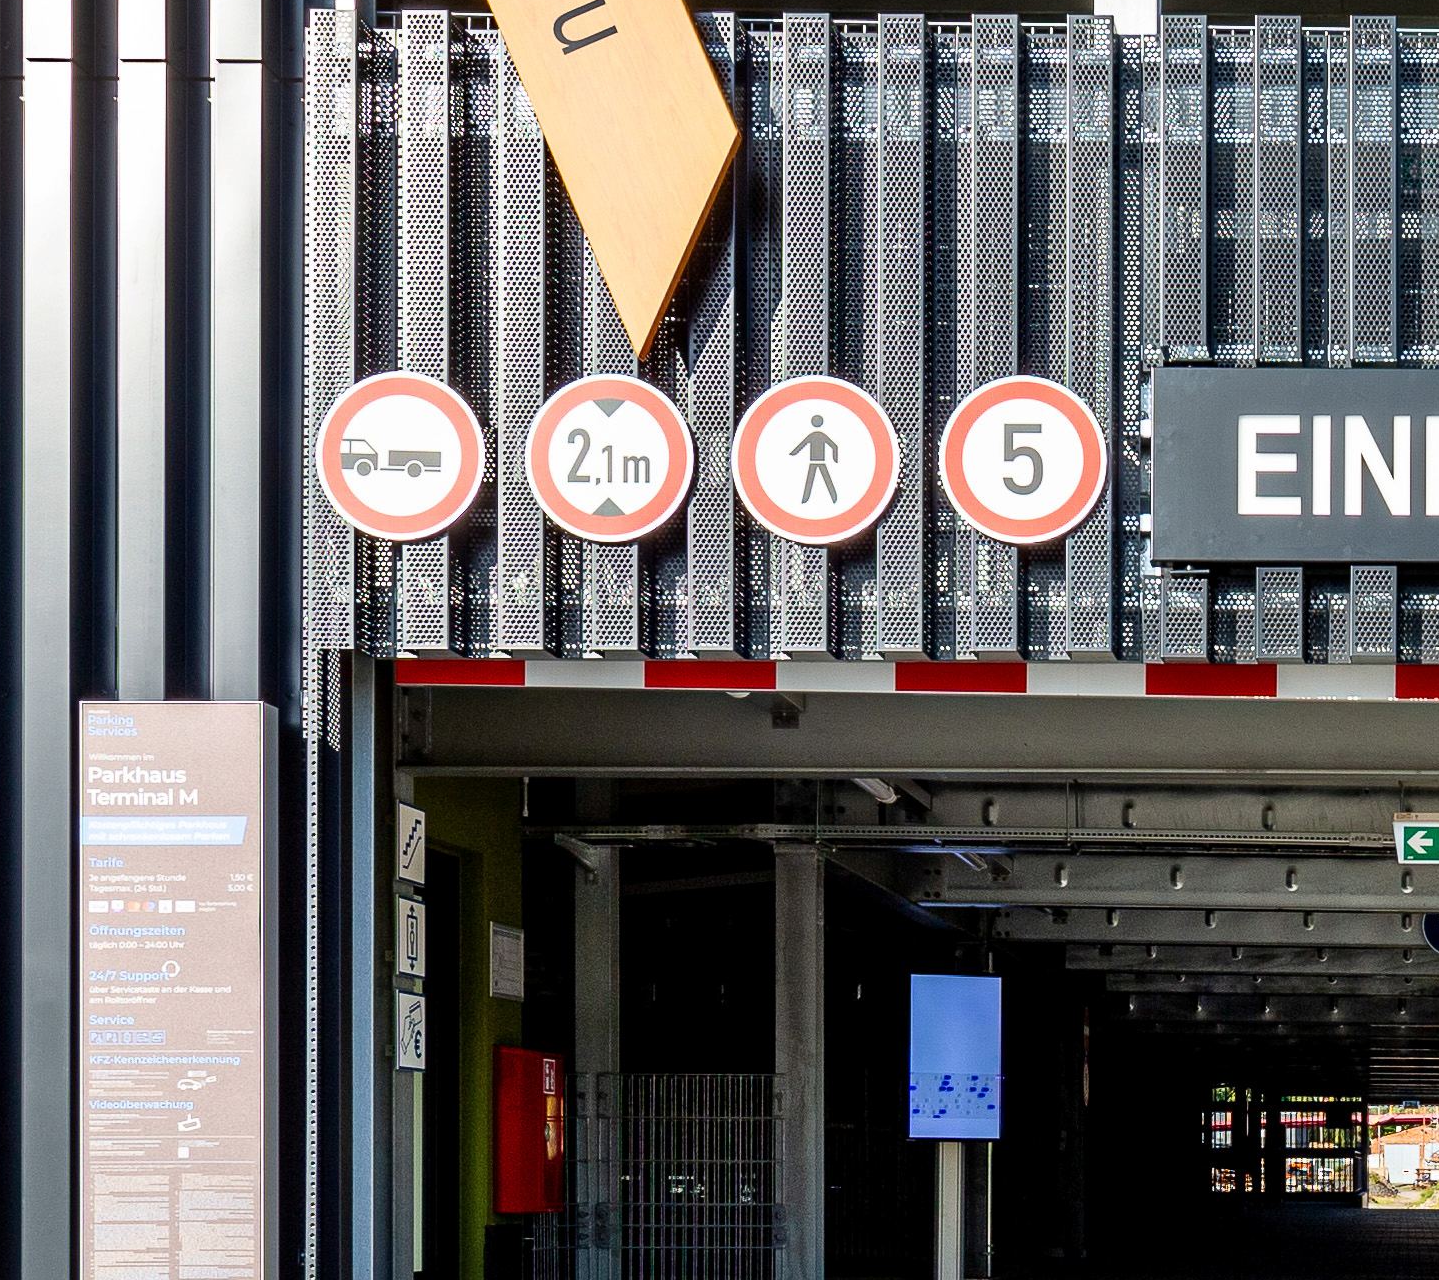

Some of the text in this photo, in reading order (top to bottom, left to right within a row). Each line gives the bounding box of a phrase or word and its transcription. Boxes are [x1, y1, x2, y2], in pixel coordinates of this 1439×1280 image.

[1002, 423, 1044, 496] 5
[88, 715, 134, 727] Parking
[88, 726, 138, 736] Services
[88, 766, 187, 783] Parkhaus
[87, 788, 198, 806] Terminal M
[89, 857, 124, 868] Tarife
[89, 924, 186, 937] Öffnungszeiten
[89, 970, 170, 982] 24/7 Support
[89, 1015, 135, 1025] Service
[89, 1055, 241, 1065] KFZ-Kennzeichenerkennung
[89, 1100, 194, 1110] Videoüberwachung
